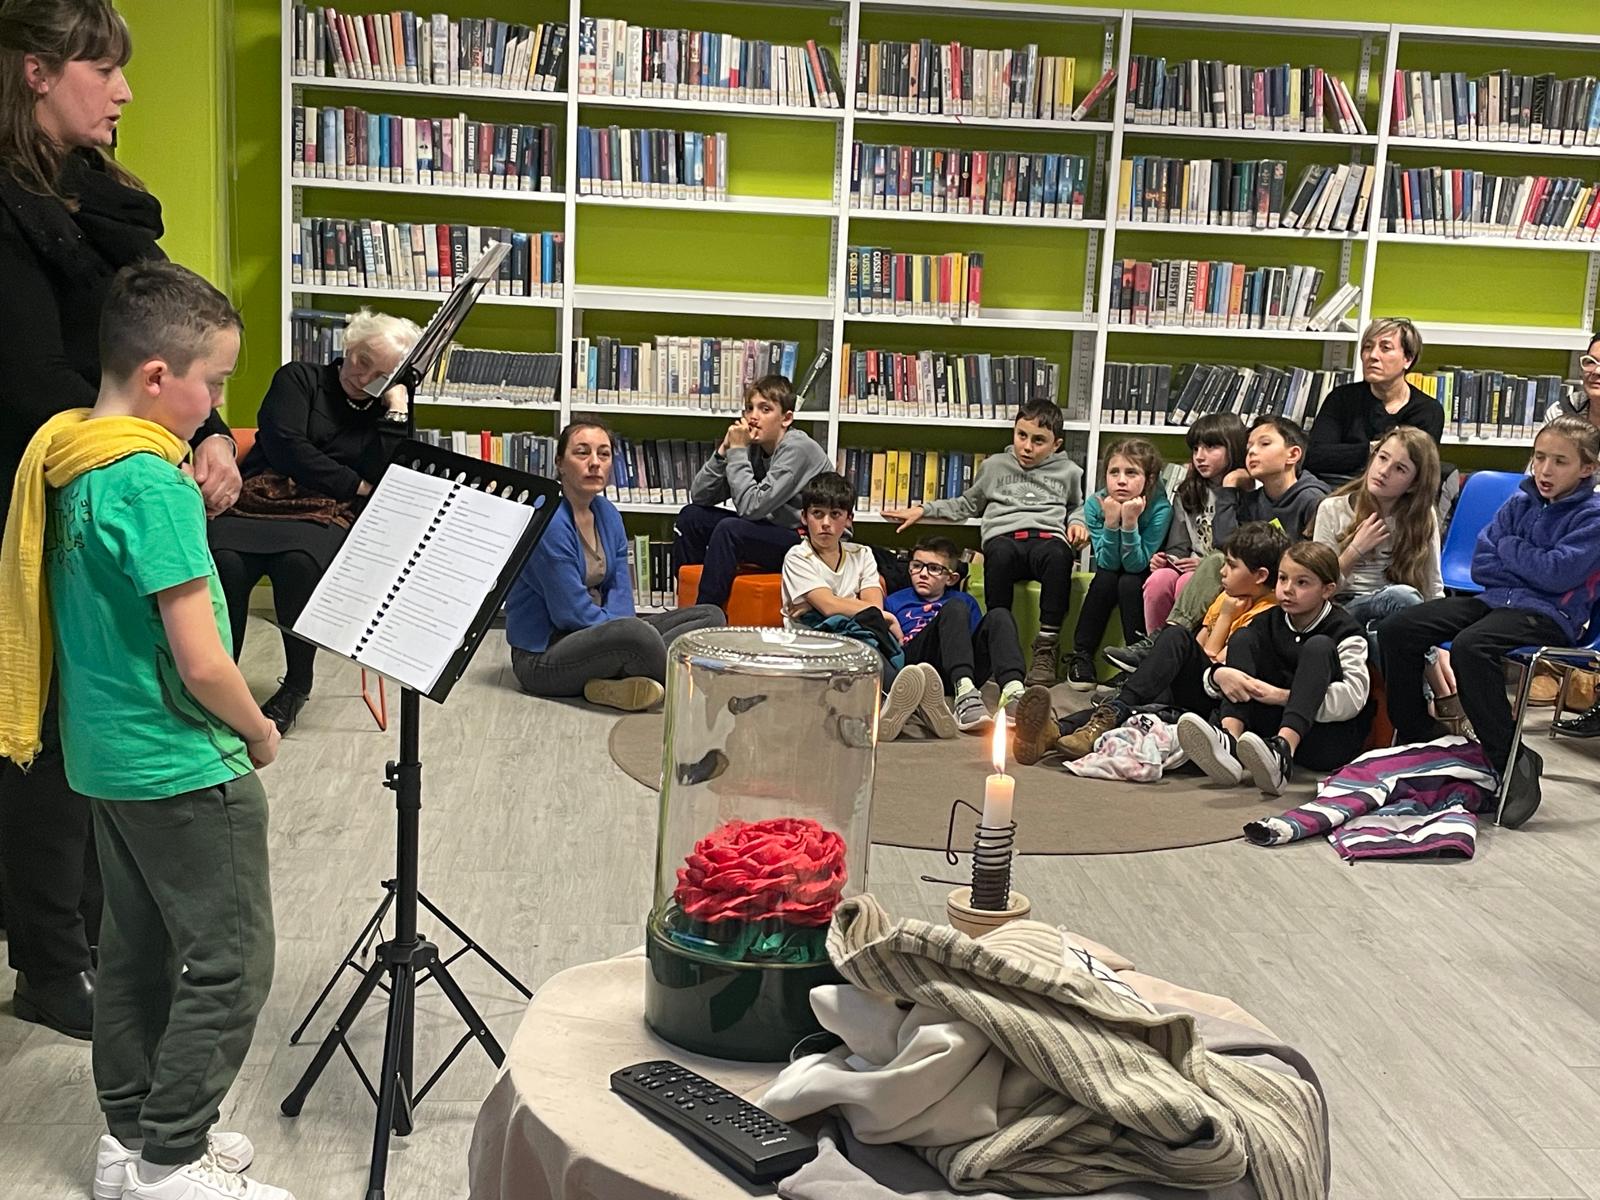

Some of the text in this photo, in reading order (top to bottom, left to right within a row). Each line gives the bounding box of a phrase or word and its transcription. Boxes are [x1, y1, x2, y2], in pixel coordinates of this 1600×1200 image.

[362, 228, 375, 271] RESPIRO
[873, 251, 882, 283] CUSSLER
[849, 252, 858, 285] CUSSLER
[862, 253, 871, 285] CUSSLER
[1168, 265, 1180, 307] FORSYTH
[1186, 265, 1198, 302] FORSYTH
